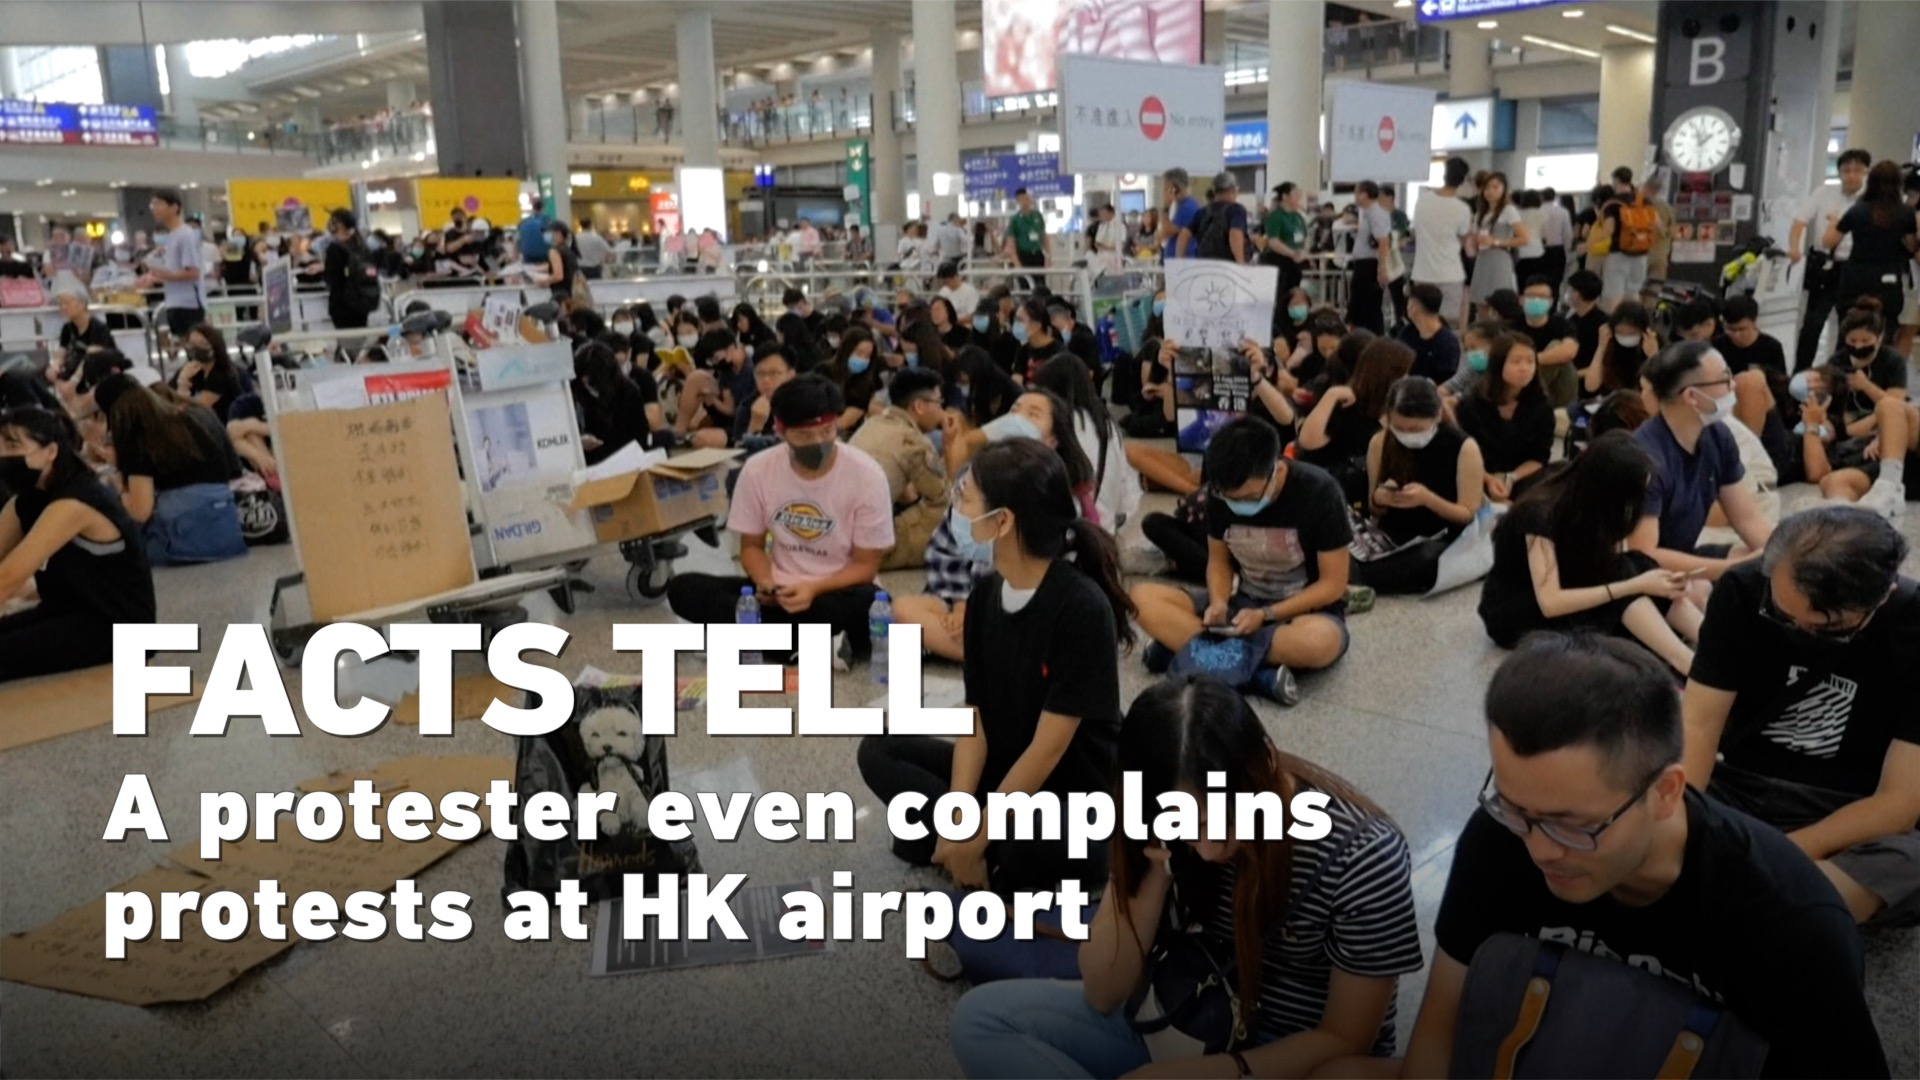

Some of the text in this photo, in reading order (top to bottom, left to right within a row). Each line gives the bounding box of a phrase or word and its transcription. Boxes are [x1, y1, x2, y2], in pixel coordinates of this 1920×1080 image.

[1689, 36, 1727, 86] B
[1170, 111, 1216, 130] No entry
[537, 434, 569, 450] KOHLER
[494, 519, 542, 541] GILDAN
